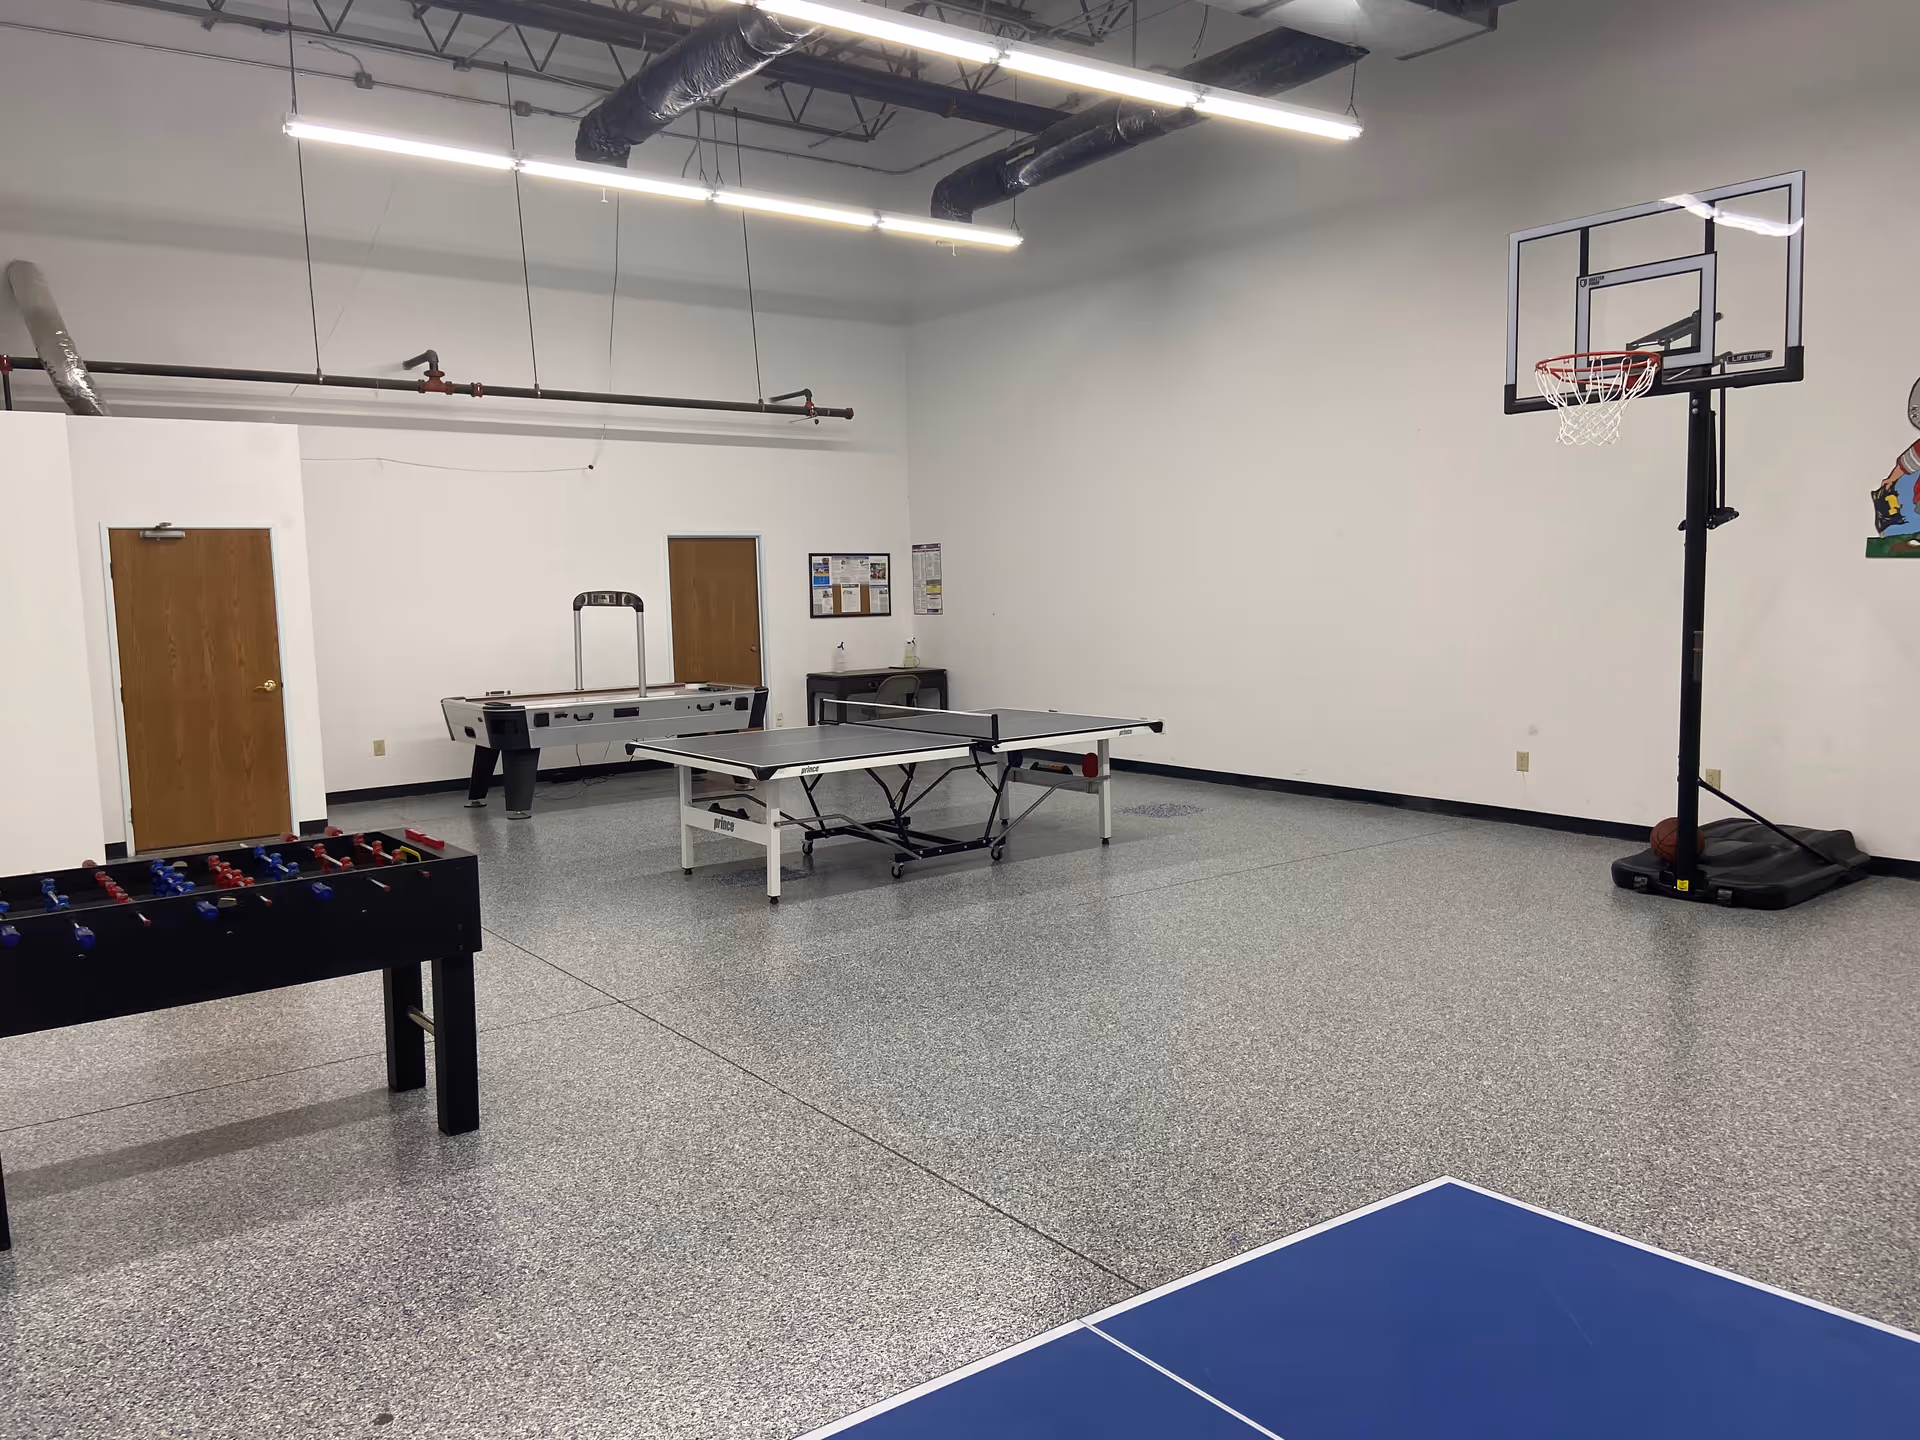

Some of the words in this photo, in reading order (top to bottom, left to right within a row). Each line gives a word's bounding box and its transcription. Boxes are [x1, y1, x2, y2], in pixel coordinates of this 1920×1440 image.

[1732, 353, 1766, 361] LIFETIME
[1119, 728, 1132, 736] prince
[801, 765, 819, 774] prince
[714, 816, 734, 832] prince
